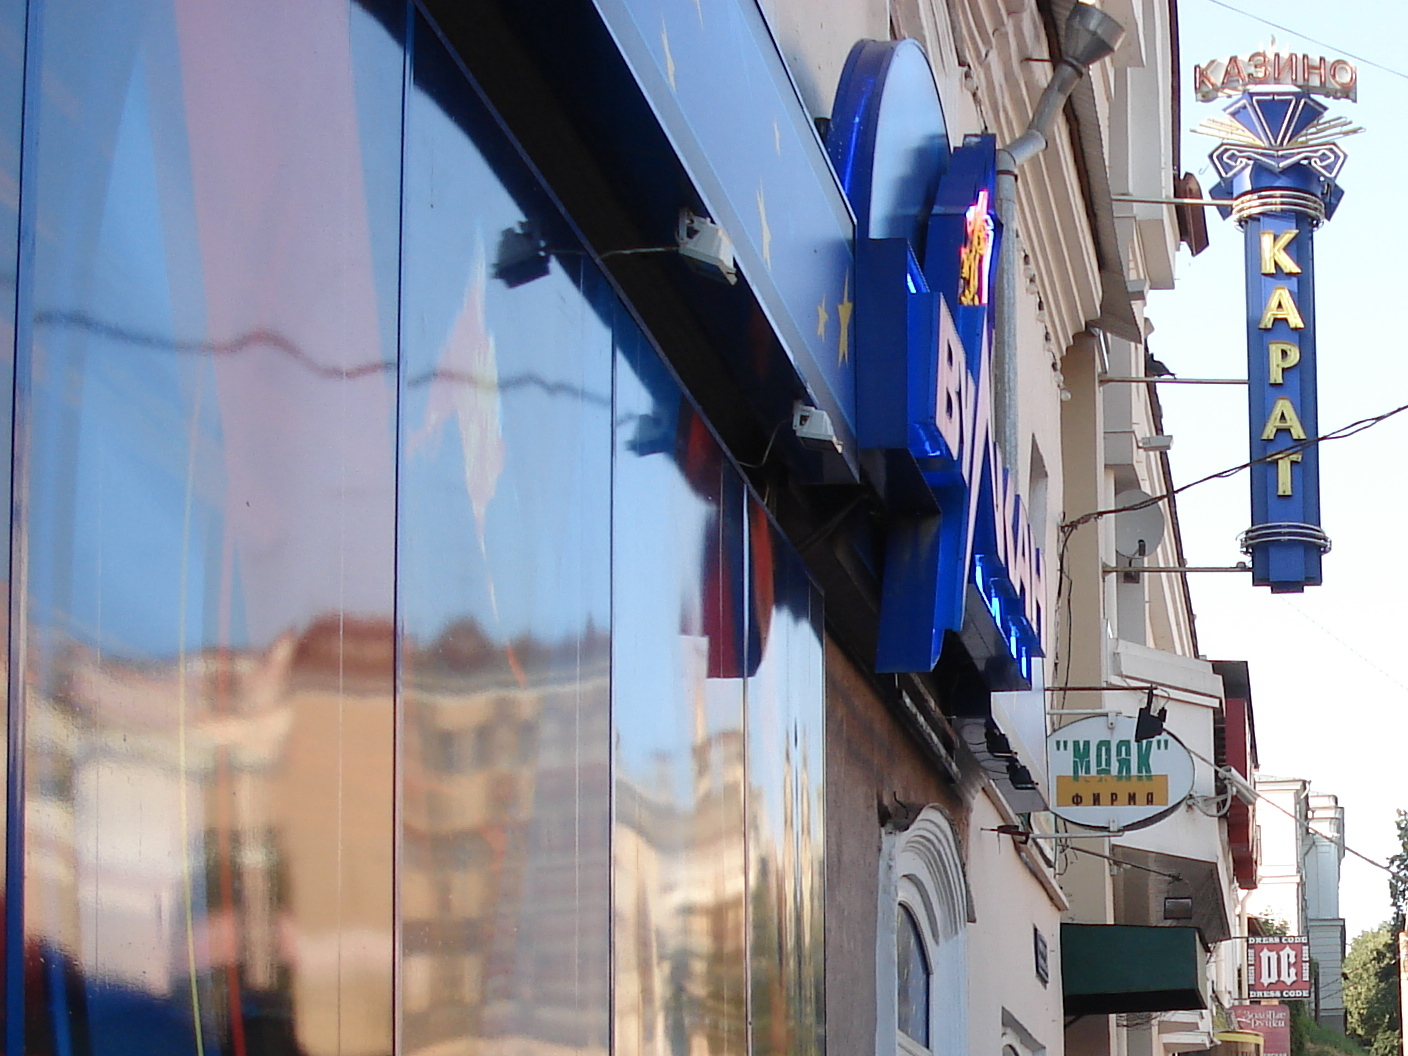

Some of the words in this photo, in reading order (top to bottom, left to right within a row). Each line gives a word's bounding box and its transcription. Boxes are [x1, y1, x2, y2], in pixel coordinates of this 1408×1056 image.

[1194, 52, 1357, 95] КАЗИНО
[1259, 230, 1307, 496] КАРАТ
[1072, 792, 1154, 806] ФИРМА
[1248, 936, 1280, 944] DRESS
[1259, 944, 1297, 987] DC
[1249, 990, 1280, 998] DRESS
[1283, 989, 1309, 997] CODE
